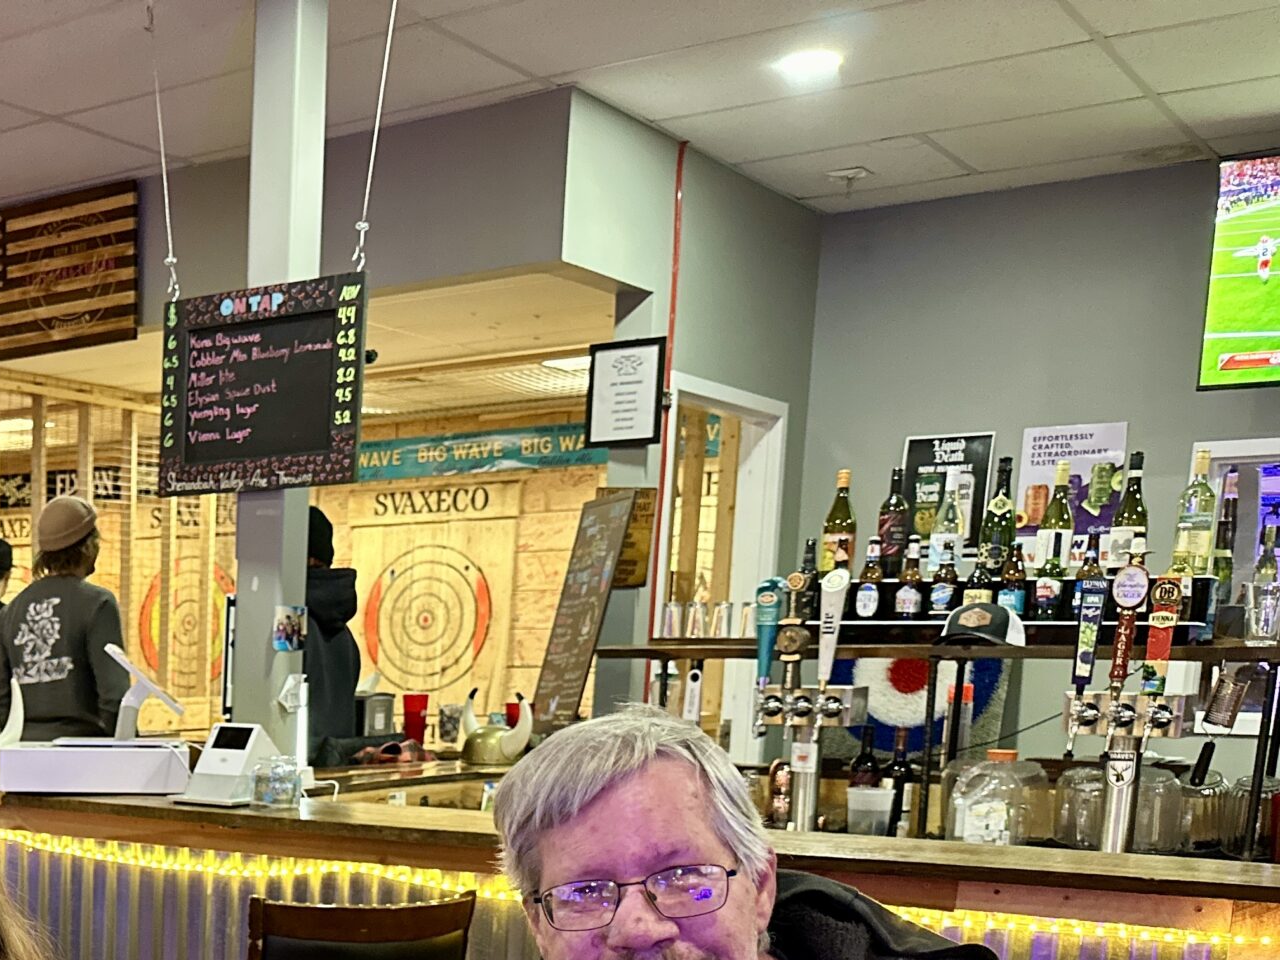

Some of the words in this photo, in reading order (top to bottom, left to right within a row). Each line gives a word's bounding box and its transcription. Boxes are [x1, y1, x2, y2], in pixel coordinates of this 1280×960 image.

[220, 298, 248, 316] ON
[249, 293, 284, 312] TAP
[167, 334, 177, 350] 6
[254, 379, 277, 395] Dust
[164, 412, 173, 427] 6
[163, 432, 174, 448] 6
[933, 438, 966, 454] Liquid
[1032, 433, 1095, 443] EFFORTLESSLY
[417, 446, 447, 464] BIG
[453, 441, 504, 461] WAVE
[521, 436, 553, 456] BIG
[934, 451, 964, 463] Death
[1030, 448, 1109, 459] EXTRAORDINARY
[167, 471, 216, 491] Shenandoah
[275, 470, 312, 485] Throwing
[374, 486, 489, 516] SVAXECO
[1160, 586, 1174, 598] DB
[1115, 625, 1129, 665] LAGER
